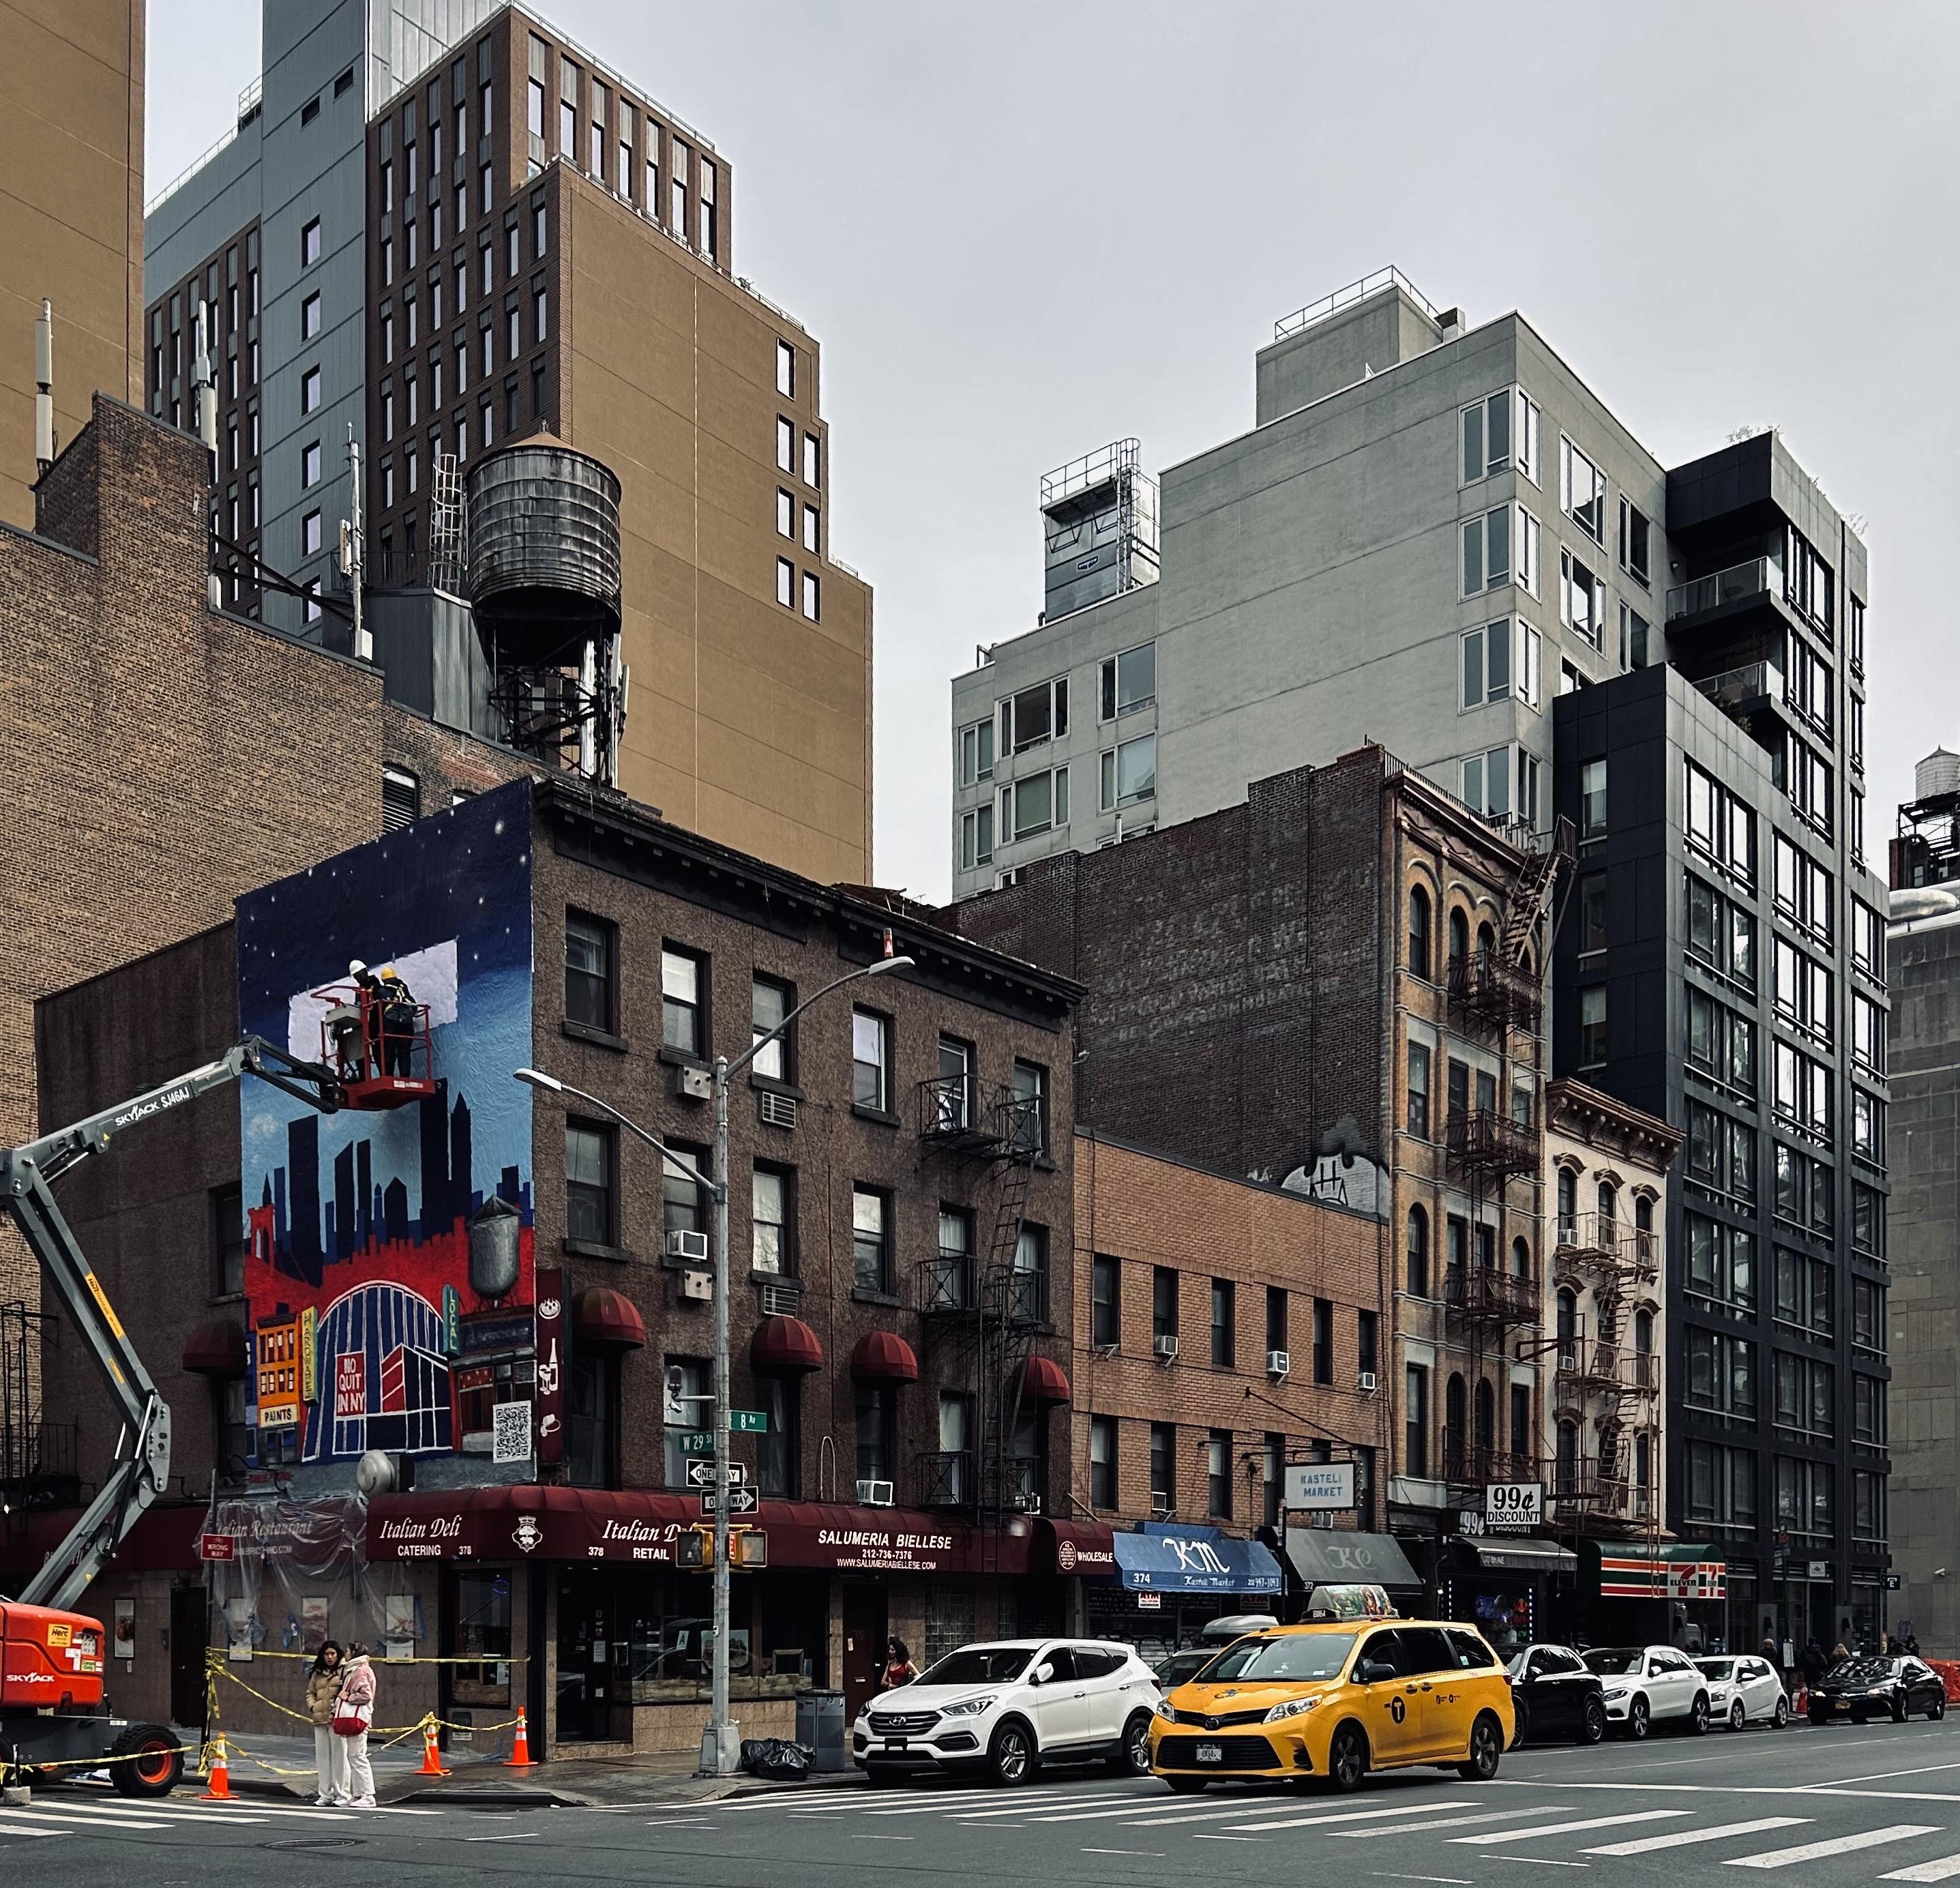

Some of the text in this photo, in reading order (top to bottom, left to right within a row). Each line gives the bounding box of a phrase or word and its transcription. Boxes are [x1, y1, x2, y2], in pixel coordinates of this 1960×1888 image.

[115, 1087, 190, 1126] SKYJACK SJ46AJ
[449, 1289, 458, 1351] LOCAL
[344, 1358, 356, 1374] NO
[339, 1373, 361, 1391] QUIT
[338, 1392, 365, 1413] IN NY
[265, 1408, 291, 1422] PAINTS
[741, 1413, 756, 1428] 8 Av
[683, 1436, 690, 1451] W
[693, 1435, 704, 1449] 29
[696, 1469, 713, 1479] ONE
[1301, 1473, 1341, 1485] KASTELI
[1303, 1486, 1343, 1497] MARKET
[1493, 1486, 1535, 1511] 99¢
[732, 1495, 749, 1506] WAY
[1487, 1511, 1540, 1522] DISCOUNT
[250, 1520, 314, 1541] Restaurant
[379, 1514, 462, 1539] Italian Deli
[602, 1519, 660, 1542] Italian
[818, 1529, 952, 1550] SALUMERIA BIELLESE
[398, 1544, 472, 1556] CATERING 378
[588, 1546, 670, 1560] 378 RETAIL
[862, 1548, 912, 1560] 212-736-7376
[1078, 1551, 1114, 1563] WHOLESALE
[1162, 1537, 1230, 1574] KM
[1133, 1573, 1150, 1583] 374
[1183, 1576, 1208, 1586] Kasteli
[1209, 1577, 1235, 1587] Market
[1304, 1581, 1313, 1590] 372
[52, 1628, 69, 1637] Herc
[6, 1672, 55, 1683] SKYJACK
[1394, 1702, 1402, 1720] T
